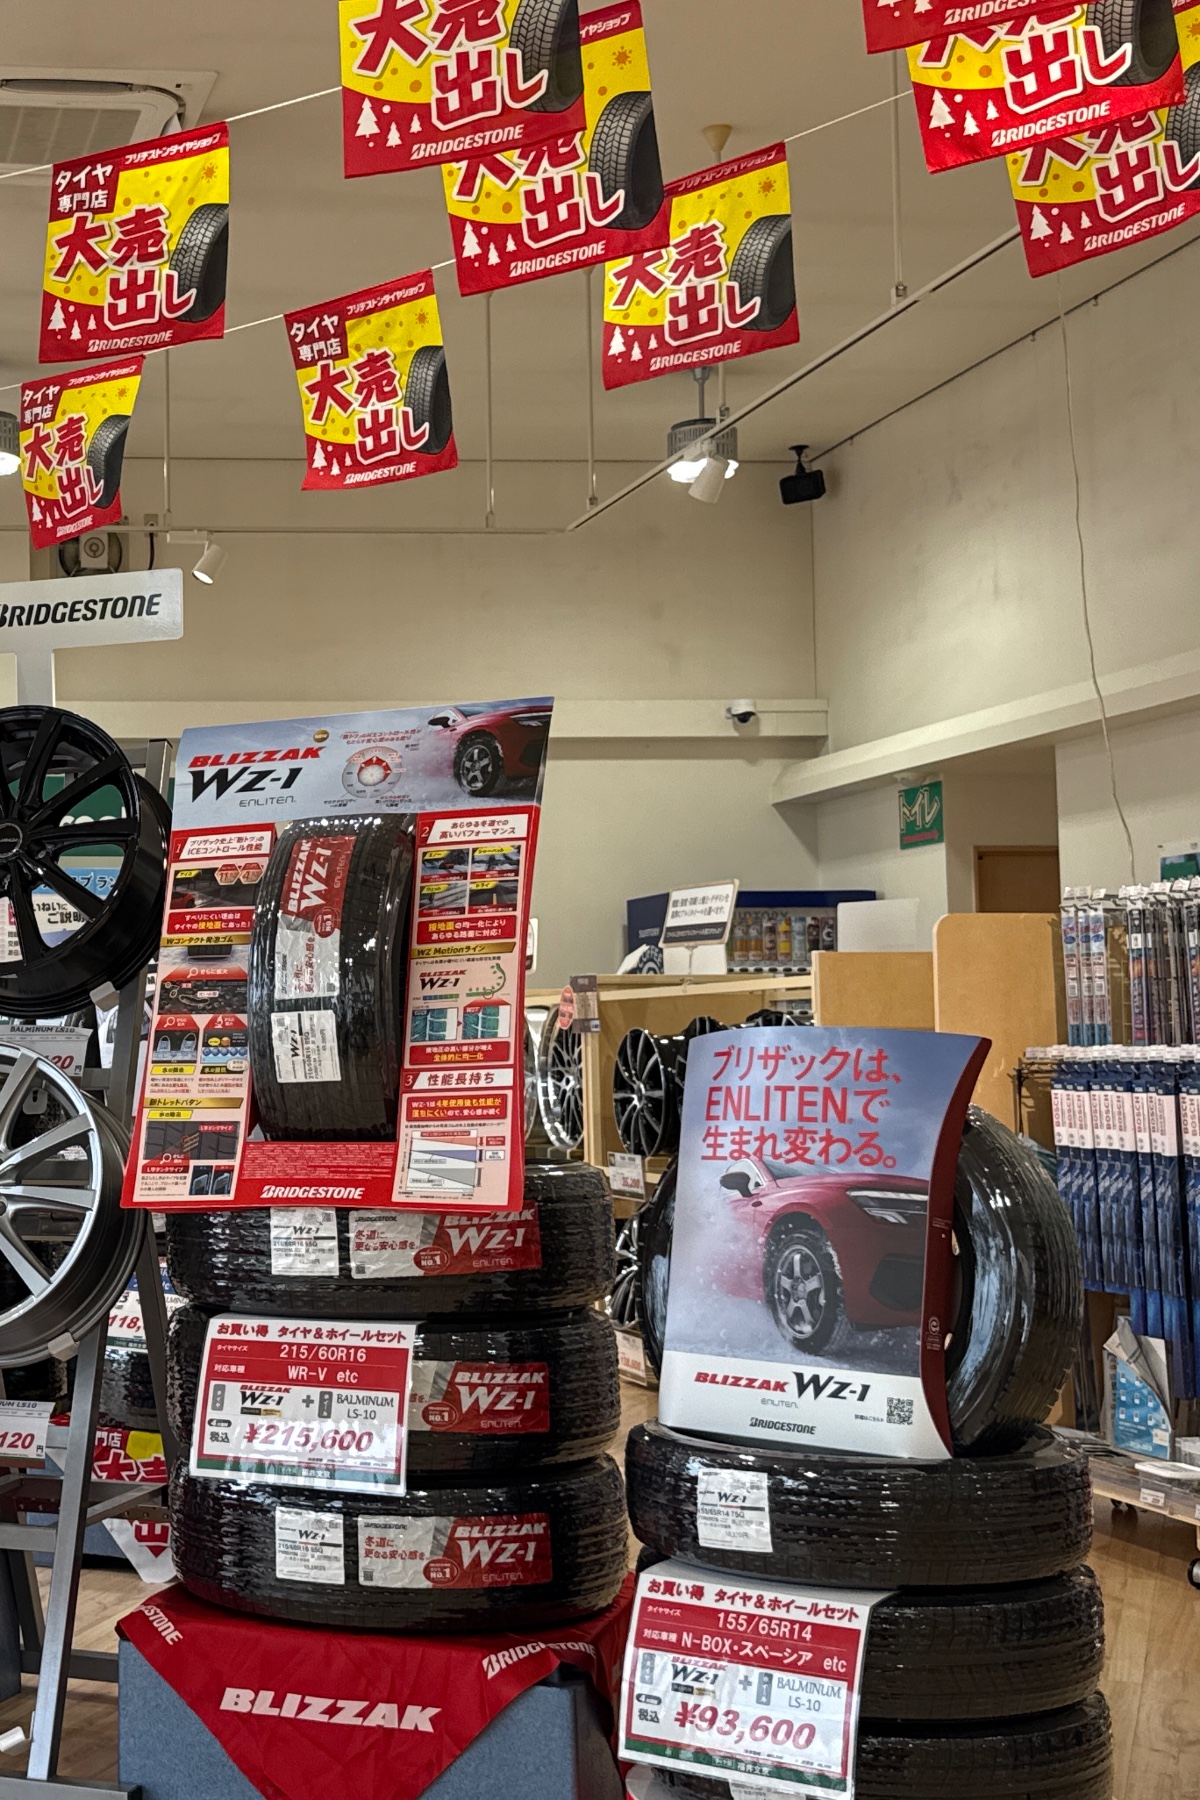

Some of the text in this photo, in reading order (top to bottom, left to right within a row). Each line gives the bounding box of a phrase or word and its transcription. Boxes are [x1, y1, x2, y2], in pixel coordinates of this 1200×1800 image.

[1084, 202, 1186, 252] BRIDGESTONE
[509, 240, 606, 278] BRIDGESTONE
[290, 314, 339, 341] タイヤ
[88, 330, 174, 353] BRIDGESTONE
[298, 338, 342, 361] 専門店
[649, 340, 742, 371] BRIDGESTONE
[23, 385, 61, 405] タイヤ
[24, 405, 54, 423] 専門店
[22, 413, 88, 480] 大売
[344, 463, 417, 486] BRIDGESTONE
[58, 466, 104, 518] 出し
[188, 746, 325, 768] BLIZZAK
[188, 767, 303, 803] WZ-1
[239, 795, 295, 808] ENLITEN
[420, 827, 430, 838] 2
[300, 847, 333, 911] WZ-1
[419, 978, 461, 991] WZ-1
[713, 1044, 902, 1085] ブリザックは、
[404, 1072, 495, 1087] 3 性能長持ち
[705, 1086, 892, 1125] ENLITENで
[1134, 1096, 1142, 1133] BOSCH
[1181, 1097, 1189, 1134] BOSCH
[701, 1127, 897, 1168] 生まれ変わる。
[260, 1185, 365, 1200] BRIDGESTONE
[446, 1226, 525, 1256] WZ-1
[217, 1323, 407, 1344] お買い得 タイヤ&ホイールセット
[280, 1344, 367, 1362] 215/60R16
[288, 1366, 327, 1381] WR-V
[336, 1369, 359, 1384] etc
[455, 1370, 545, 1384] BLIZZAK
[695, 1371, 871, 1402] BLIZZAK WZ-1
[239, 1385, 292, 1393] BLIZZAK
[240, 1392, 284, 1406] WZ-1
[336, 1393, 394, 1408] BALMINUM
[455, 1386, 533, 1414] WZ-1
[347, 1409, 377, 1420] LS-10
[749, 1417, 816, 1435] BRIDGESTONE
[209, 1431, 230, 1444] 税込
[243, 1422, 374, 1453] ¥215,600
[454, 1522, 547, 1538] BLIZZAK
[457, 1540, 535, 1569] WZ-1
[647, 1578, 859, 1622] お買い得 タイヤ&ホイールセット
[717, 1612, 812, 1641] 155/65R14
[681, 1631, 812, 1667] N-BOX・スペーシア
[823, 1658, 847, 1673] etc
[671, 1664, 719, 1685] WZ-1
[776, 1676, 842, 1699] BALMINUM
[220, 1688, 442, 1733] BLIZZAK
[788, 1696, 821, 1712] LS-10
[638, 1708, 660, 1724] 税込
[674, 1701, 816, 1750] ¥93,600
